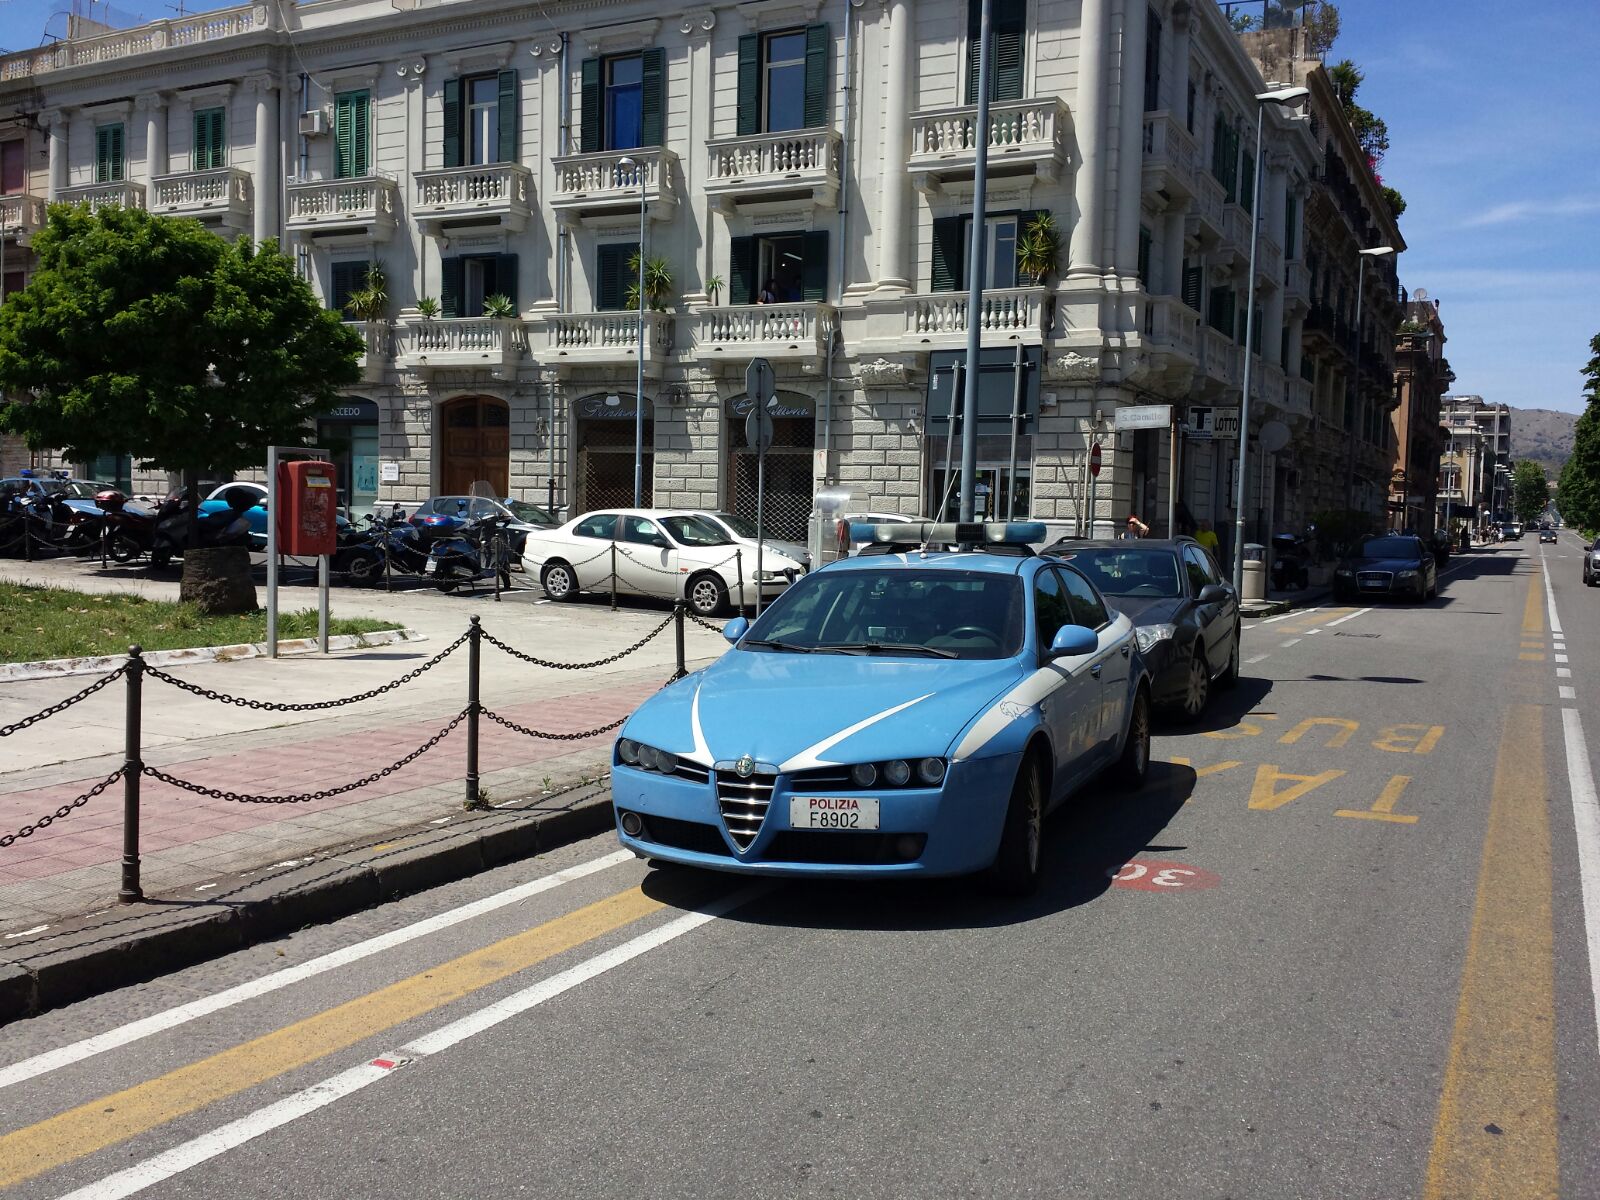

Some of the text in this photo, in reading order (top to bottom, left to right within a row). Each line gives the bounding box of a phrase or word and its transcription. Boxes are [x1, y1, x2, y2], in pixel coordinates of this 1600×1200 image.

[1130, 412, 1162, 421] Camillo
[1214, 417, 1238, 432] LOTTO
[809, 799, 860, 810] POLIZIA
[810, 811, 859, 828] F8902
[1105, 863, 1196, 887] 30
